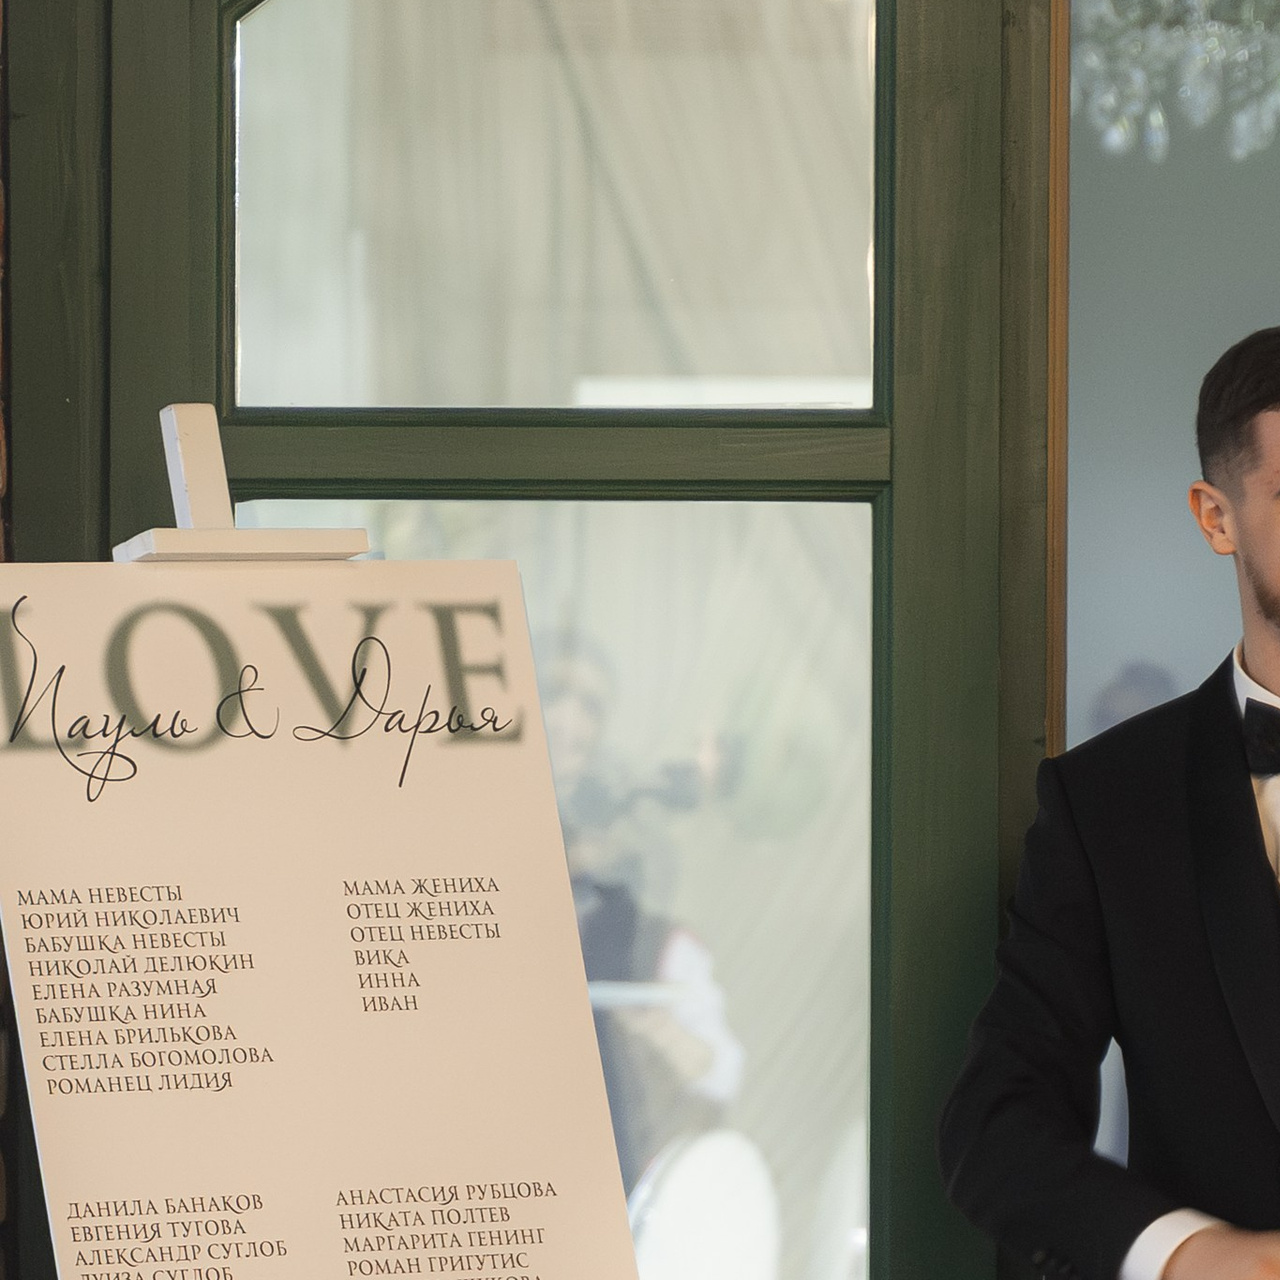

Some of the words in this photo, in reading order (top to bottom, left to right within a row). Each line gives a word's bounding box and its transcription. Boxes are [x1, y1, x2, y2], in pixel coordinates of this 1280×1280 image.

[9, 595, 199, 803] Пауль
[216, 664, 279, 739] &
[292, 636, 514, 788] Дарья
[17, 889, 82, 906] МАМА
[88, 885, 183, 905] НЕВЕСТЫ
[343, 879, 406, 896] МАМА
[410, 877, 500, 897] ЖЕНИХА
[21, 909, 89, 930] ЮРИЙ
[95, 907, 241, 929] НИКОЛАЕВИЧ
[346, 903, 401, 920] ОТЕЦ
[407, 900, 495, 920] ЖЕНИХА
[24, 934, 125, 954] БАБУШКА
[132, 931, 227, 950] НЕВЕСТЫ
[350, 926, 405, 943] ОТЕЦ
[410, 923, 502, 941] НЕВЕСТЫ
[28, 955, 137, 979] НИКОЛАЙ
[143, 953, 255, 974] ДЕЛЮКИН
[353, 949, 410, 968] ВИКА
[31, 983, 101, 1001] ЕЛЕНА
[107, 978, 218, 999] РАЗУМНАЯ
[358, 972, 421, 989] ИННА
[35, 1005, 136, 1025] БАБУШКА
[143, 1002, 207, 1020] НИНА
[362, 995, 419, 1012] ИВАН
[39, 1030, 108, 1047] ЕЛЕНА
[115, 1025, 238, 1045] БРИЛЬКОВА
[42, 1053, 124, 1071] СТЕЛЛА
[130, 1047, 274, 1069] БОГОМОЛОВА
[46, 1075, 153, 1095] РОМАНЕЦ
[158, 1072, 233, 1092] ЛИДИЯ
[335, 1185, 459, 1206] АНАСТАСИЯ
[466, 1181, 557, 1201] РУБЦОВА
[67, 1200, 158, 1220] ДАНИЛА
[165, 1194, 263, 1215] БАНАКОВ
[431, 1206, 511, 1225] ПОЛТЕВ
[71, 1222, 161, 1243] ЕВГЕНИЯ
[167, 1219, 247, 1237] ТУГОВА
[343, 1232, 461, 1253] МАРГАРИТА
[467, 1228, 546, 1248] ГЕНИНГ
[74, 1245, 201, 1267] АЛЕКСАНДР
[207, 1240, 288, 1259] СУГЛОБ
[347, 1257, 421, 1276] РОМАН
[428, 1252, 530, 1273] ГРИГУТИС
